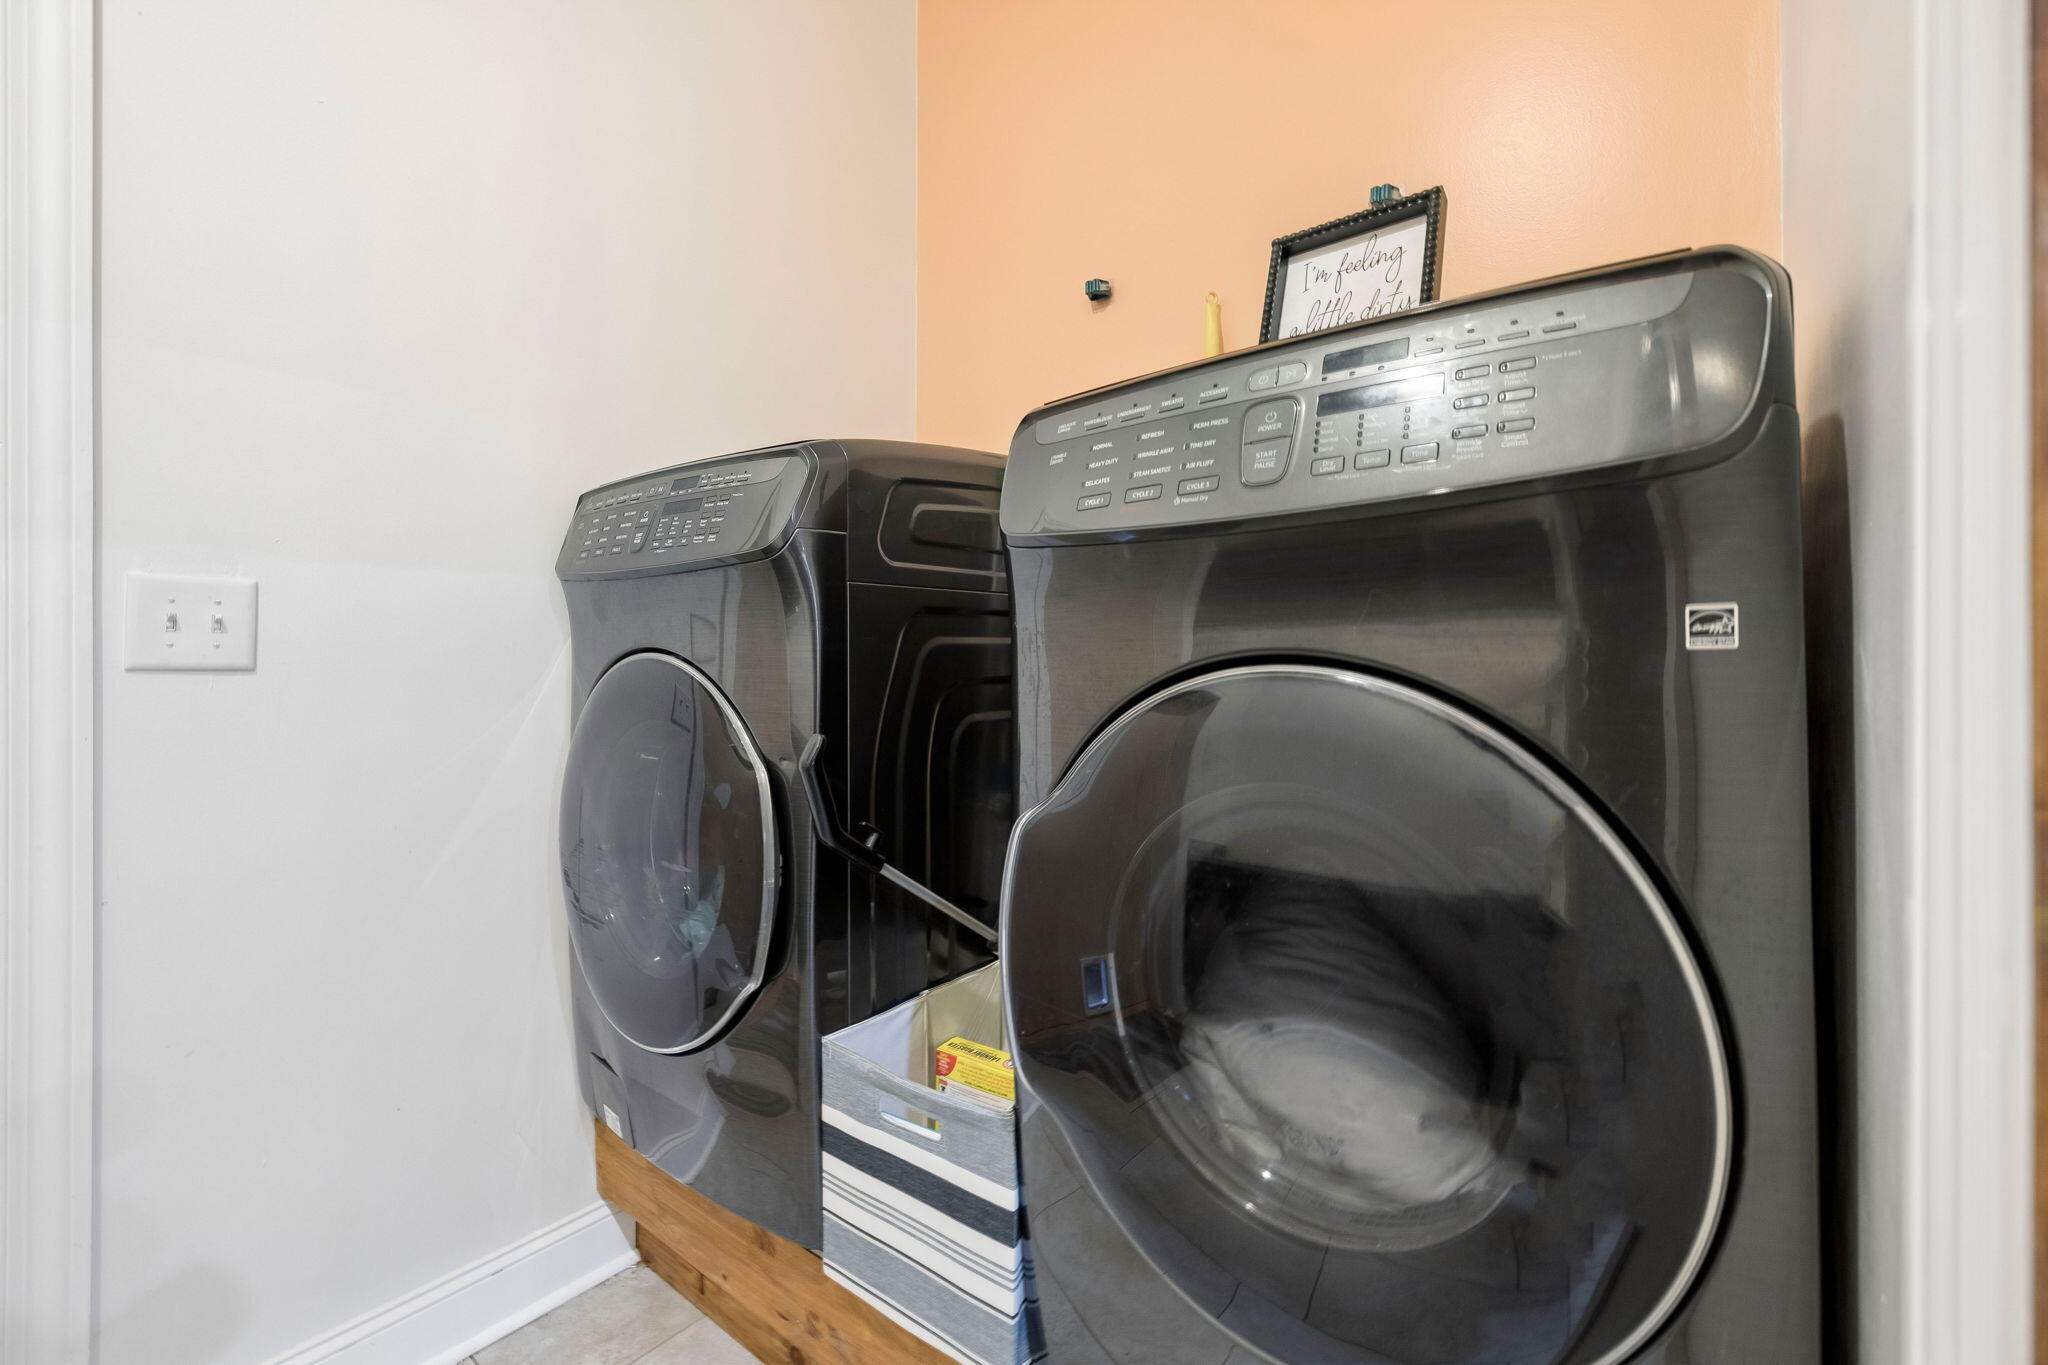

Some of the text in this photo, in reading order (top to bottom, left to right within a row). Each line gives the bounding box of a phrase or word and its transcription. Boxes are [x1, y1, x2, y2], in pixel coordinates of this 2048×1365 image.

[1302, 233, 1407, 294] I'm feeling
[1289, 326, 1302, 338] a
[1305, 290, 1356, 334] little
[1193, 417, 1229, 429] PERM PRESS
[1257, 422, 1282, 432] POWER
[1141, 430, 1165, 440] REFRESH
[1092, 442, 1113, 451] NORMAL
[1190, 439, 1217, 449] TIME DRY
[1137, 446, 1175, 459] WRINKLE AWAY
[1255, 449, 1277, 459] START
[1088, 457, 1119, 469] HEAVY DUTY
[1196, 459, 1215, 468] FLUFF
[1254, 460, 1276, 470] PAUSE
[1133, 466, 1172, 478] STEAM SANITIZE
[1085, 476, 1111, 487] DELICATES
[1186, 482, 1204, 490] CYCLE
[1132, 490, 1149, 498] CYCLE
[1084, 498, 1100, 506] CYCLE
